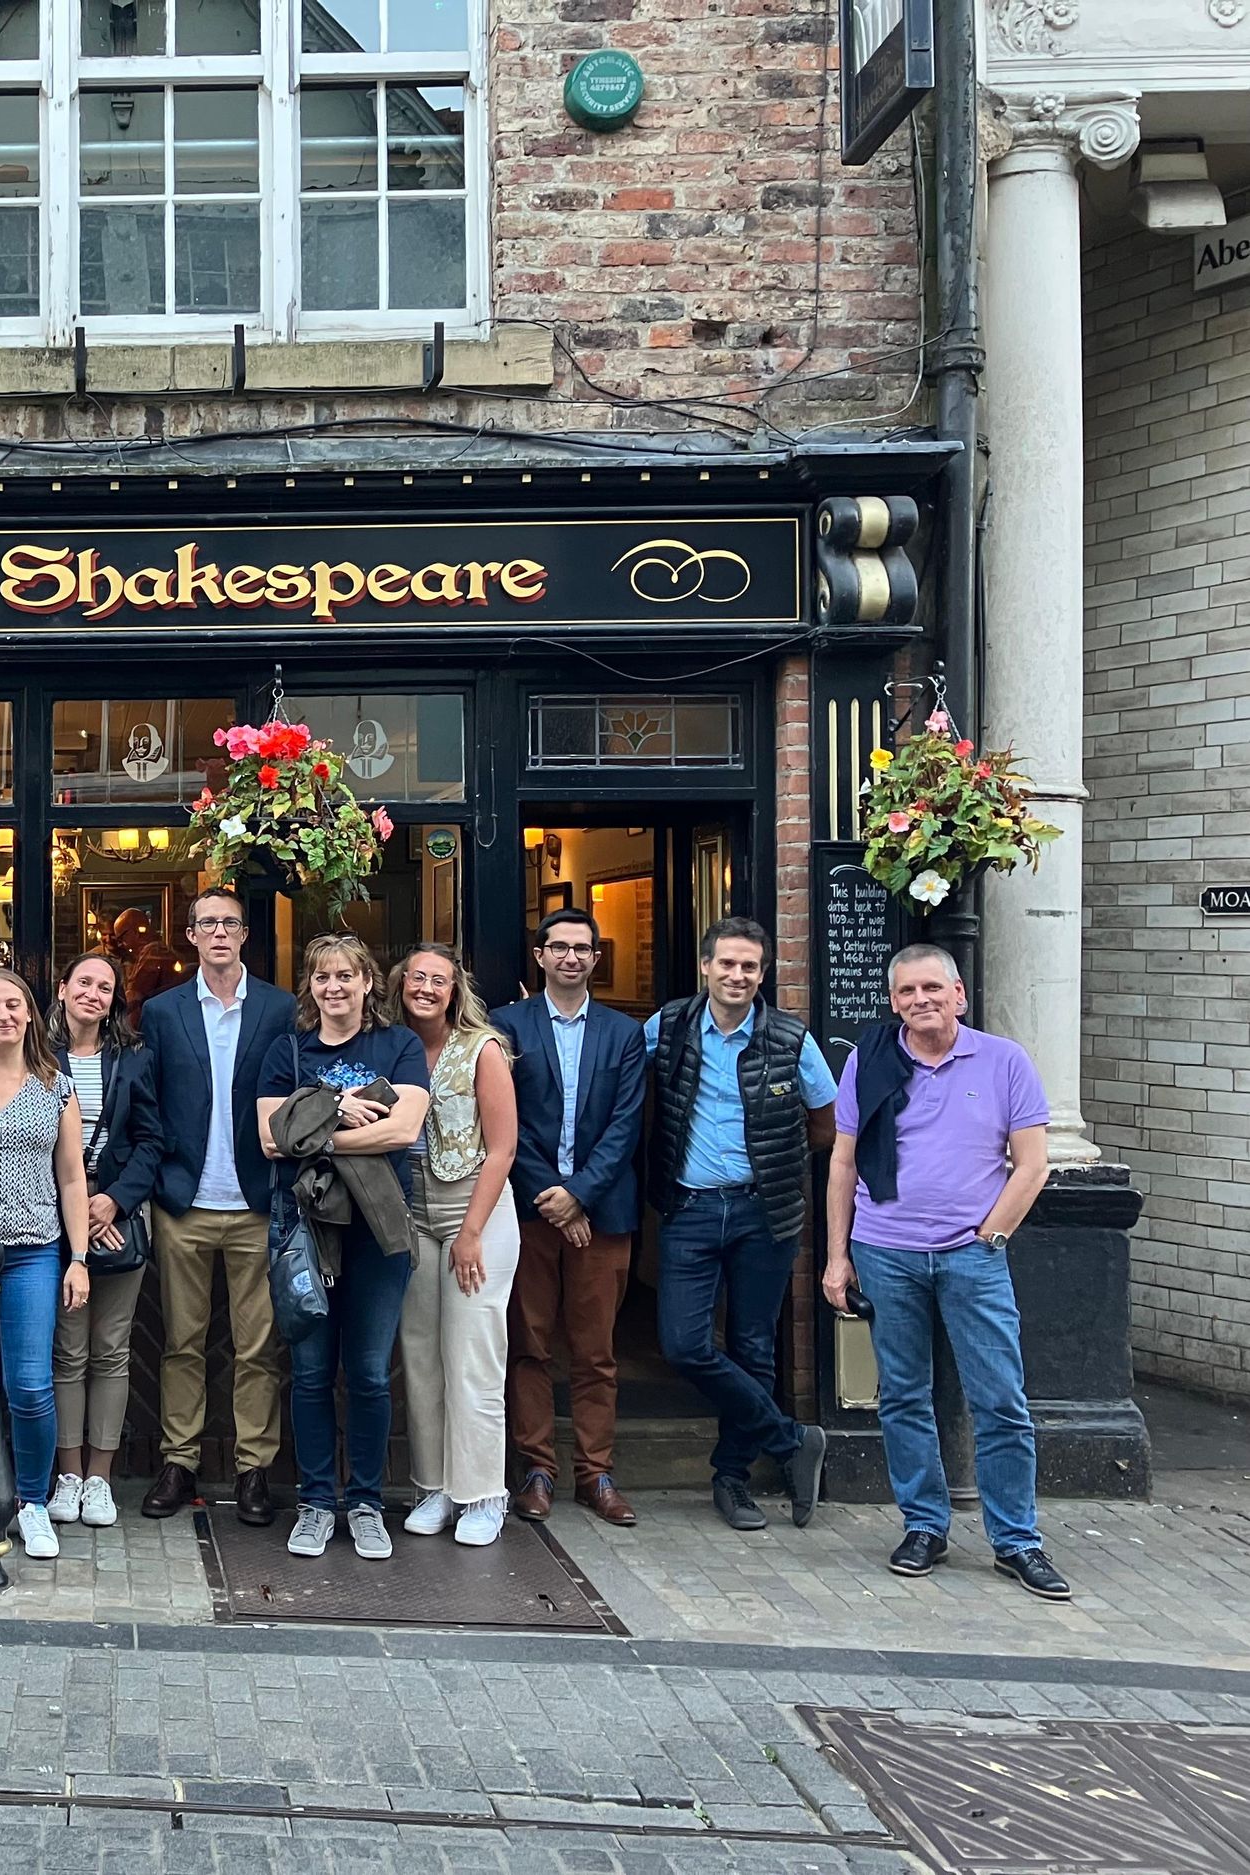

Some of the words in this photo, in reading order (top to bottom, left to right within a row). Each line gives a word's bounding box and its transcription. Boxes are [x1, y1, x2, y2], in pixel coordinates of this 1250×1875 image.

[583, 56, 635, 78] AUTOMATIC
[0, 542, 548, 623] Shakespeare
[830, 882, 849, 898] This
[855, 882, 887, 902] building
[827, 900, 849, 912] dates
[854, 900, 872, 912] back
[875, 902, 886, 912] to
[1211, 891, 1250, 908] MOA
[858, 913, 865, 925] it
[869, 916, 886, 925] was
[828, 928, 838, 938] an
[857, 926, 883, 938] called
[828, 940, 842, 952] the
[830, 951, 838, 963] in
[876, 952, 883, 963] it
[830, 963, 862, 976] remains
[868, 967, 883, 976] one
[830, 978, 838, 989] of
[841, 978, 856, 989] the
[860, 979, 882, 989] most
[830, 992, 866, 1005] Haunted
[870, 991, 890, 1005] Pubs
[830, 1005, 838, 1018] in
